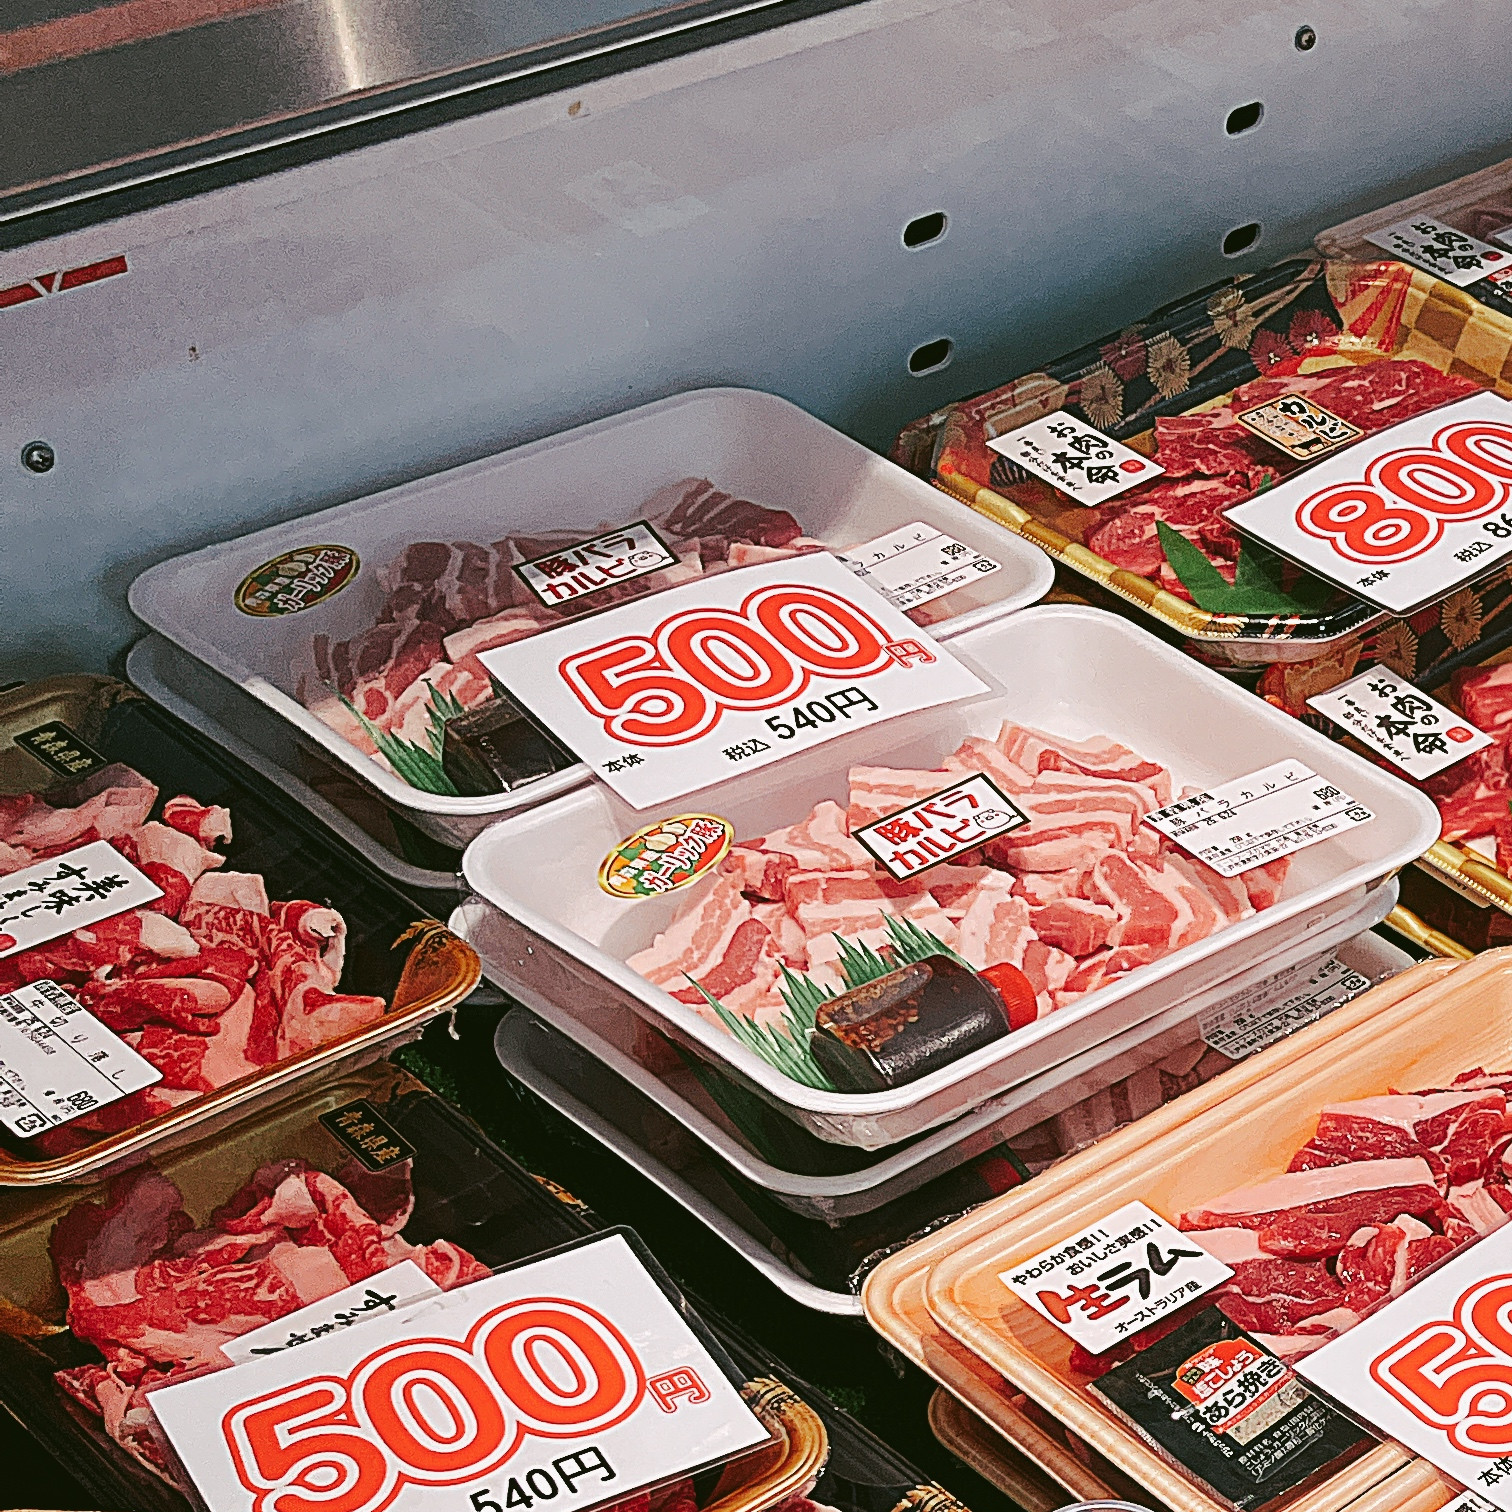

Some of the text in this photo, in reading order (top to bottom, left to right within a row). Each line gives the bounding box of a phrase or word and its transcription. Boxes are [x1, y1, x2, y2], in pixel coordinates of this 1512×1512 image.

[538, 533, 638, 580] 豚バラ
[1454, 541, 1492, 563] 税込
[540, 557, 627, 600] カルビ
[1357, 569, 1391, 589] 本体
[558, 584, 937, 747] 500円
[722, 686, 879, 762] 税込 540円
[602, 753, 645, 774] 本体
[873, 790, 982, 844] 豚バラ
[889, 821, 974, 870] カルビ
[1036, 1241, 1204, 1325] 生ラム
[1114, 1281, 1203, 1334] オーストラリア産
